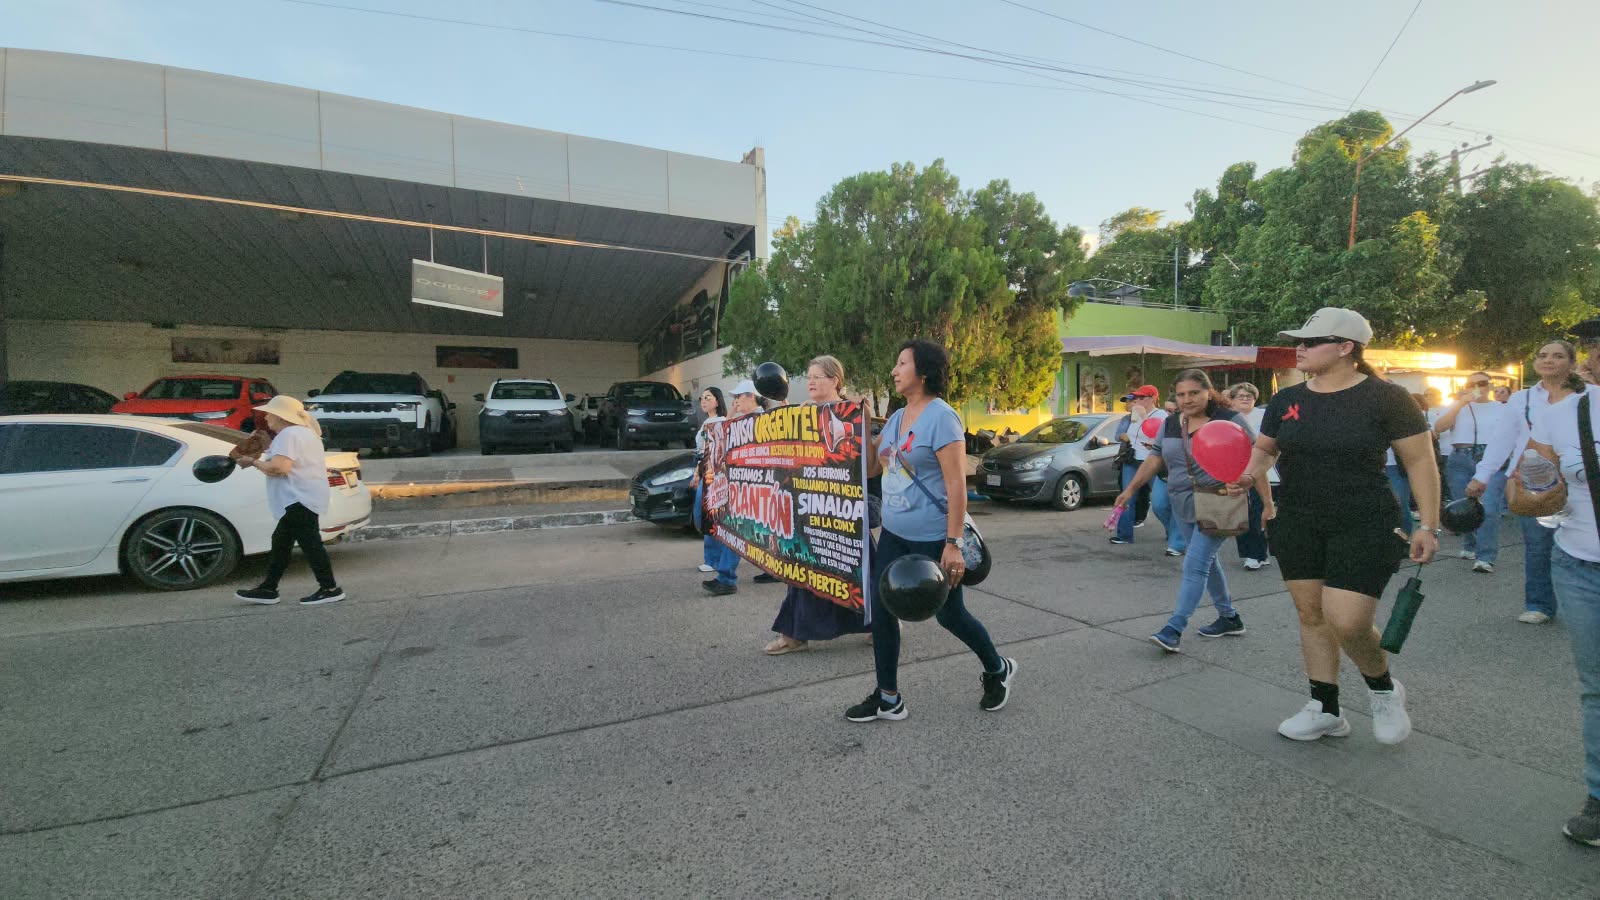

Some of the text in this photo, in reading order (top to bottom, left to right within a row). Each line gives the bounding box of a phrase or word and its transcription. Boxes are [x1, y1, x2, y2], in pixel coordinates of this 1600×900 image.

[754, 404, 821, 444] URGENTE!
[796, 445, 804, 457] TU
[804, 445, 825, 459] APOYO
[729, 467, 775, 484] ASISTAMOS AL
[803, 466, 851, 482] DOS NEURONAS
[792, 477, 829, 493] TRABAJANDO
[829, 481, 841, 495] POR
[728, 480, 794, 540] PLANTÓN
[797, 492, 864, 521] SINALOA
[809, 515, 856, 534] EN LA CDMX
[826, 540, 836, 550] QUE
[765, 553, 783, 575] SOMOS
[783, 562, 807, 583] MÁS
